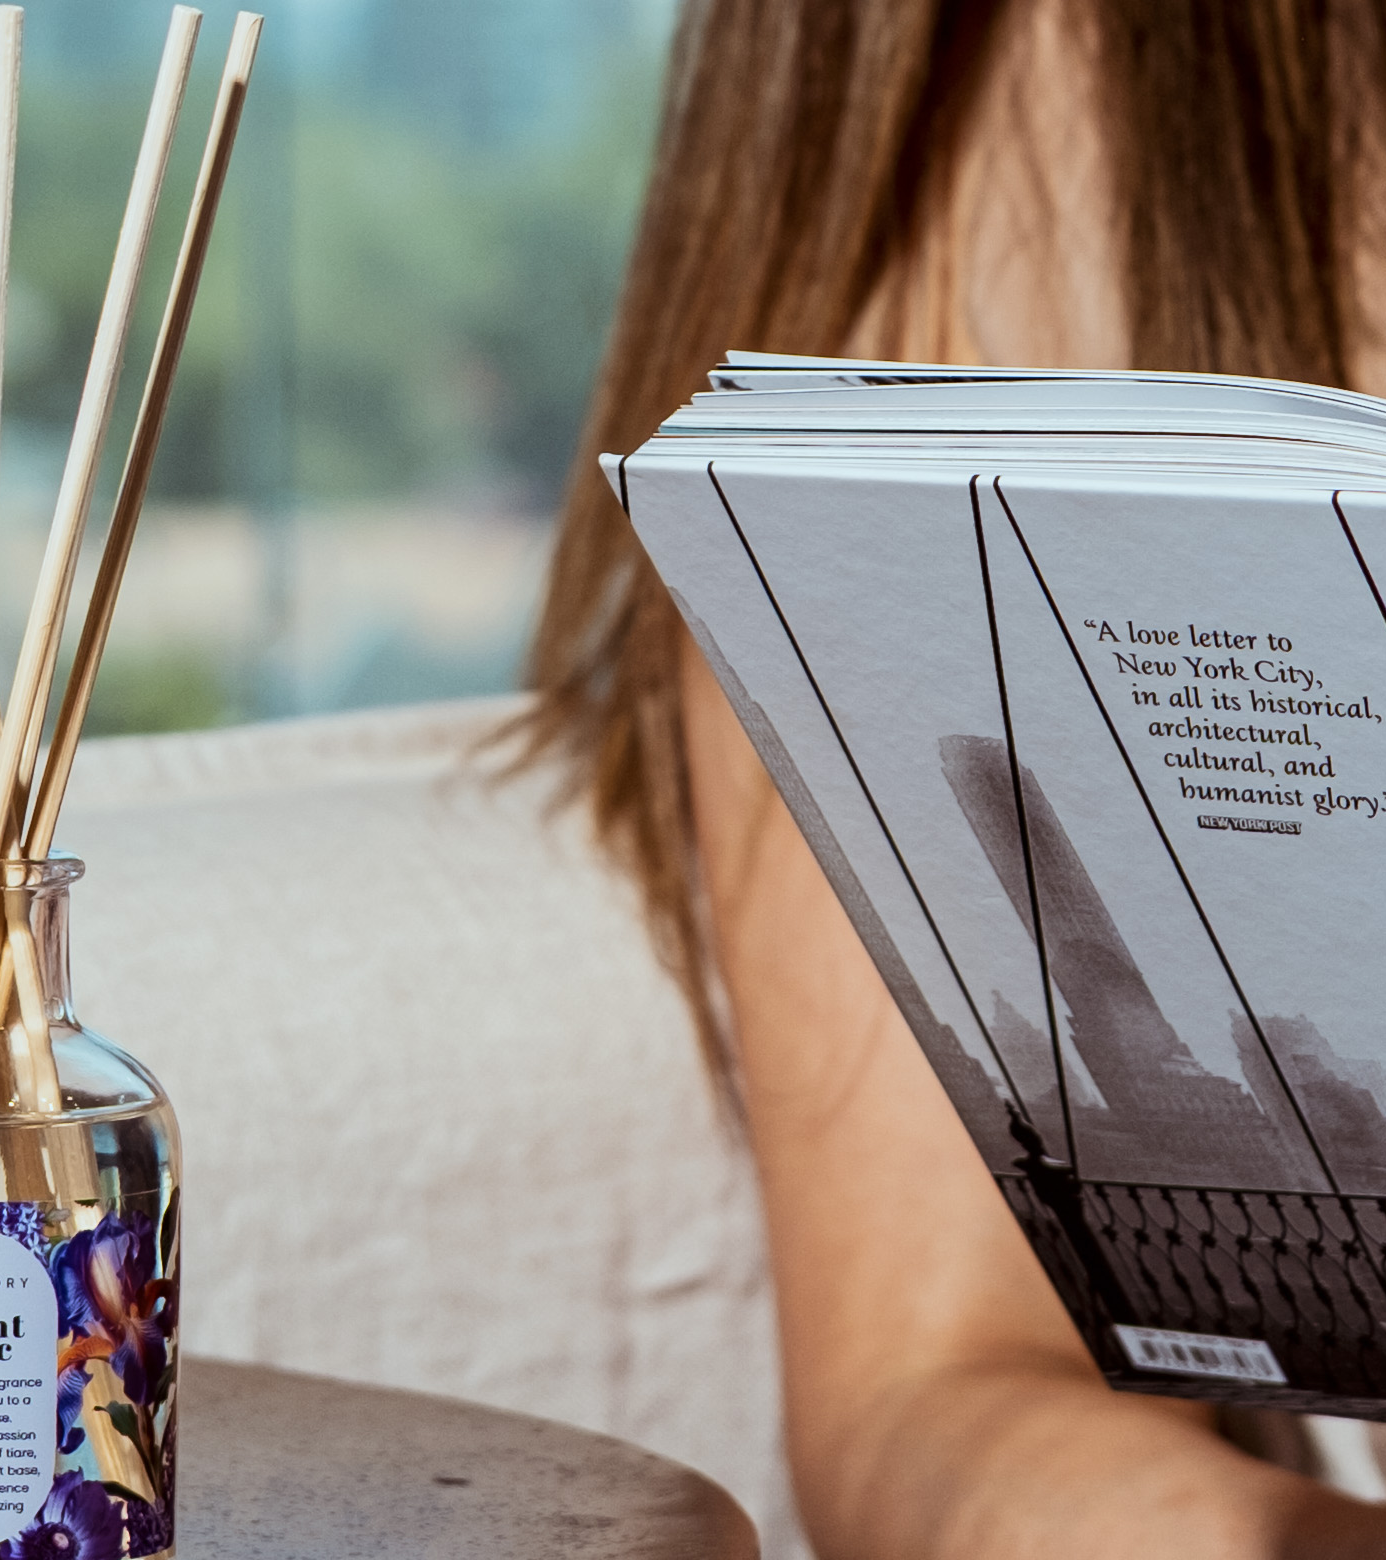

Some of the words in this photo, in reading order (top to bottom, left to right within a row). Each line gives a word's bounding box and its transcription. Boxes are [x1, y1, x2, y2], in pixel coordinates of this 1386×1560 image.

[1127, 621, 1181, 645] love
[1189, 624, 1257, 649] letter
[1268, 634, 1292, 652] to
[1112, 652, 1176, 676] New
[1183, 656, 1249, 680] York
[1254, 660, 1323, 691] City,
[1131, 683, 1160, 706] in
[1169, 686, 1203, 709] all
[1211, 688, 1241, 711] its
[1249, 690, 1382, 723] historical,
[1148, 717, 1322, 750] architectural,
[1164, 747, 1275, 777] cultural,
[1284, 756, 1336, 778] and
[1179, 777, 1304, 807] humanist
[1197, 816, 1228, 830] NEW
[1232, 818, 1267, 832] YORK
[1269, 821, 1301, 834] POST
[7, 1396, 19, 1405] to
[6, 1448, 37, 1459] tiare,
[7, 1466, 40, 1477] base,
